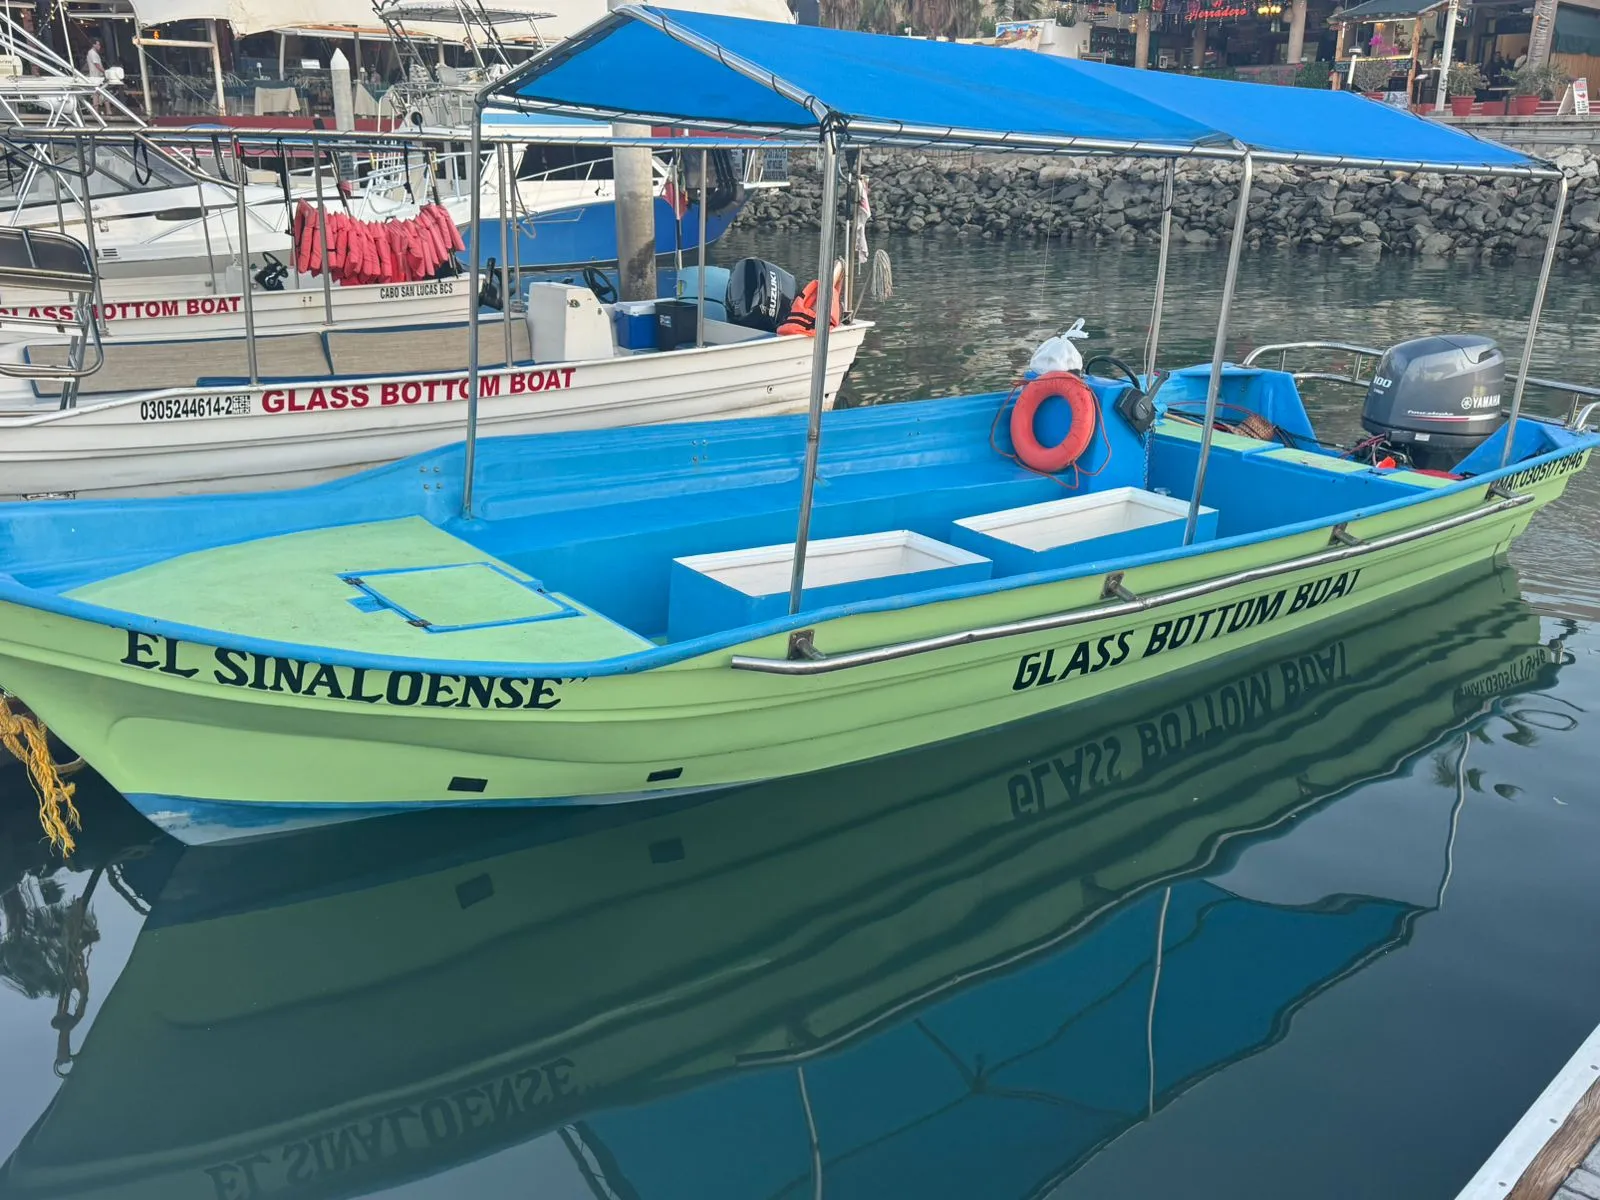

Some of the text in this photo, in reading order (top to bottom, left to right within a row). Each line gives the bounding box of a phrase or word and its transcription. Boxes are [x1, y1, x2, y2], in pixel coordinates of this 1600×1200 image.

[186, 297, 241, 315] BOAT
[380, 282, 453, 299] CABO SAN LUCAS BCS
[768, 271, 777, 318] SUZUKI
[262, 384, 369, 413] GLASS
[509, 368, 576, 394] BOAT
[1373, 376, 1392, 388] 100
[140, 396, 232, 420] 0305244614-2
[1012, 568, 1363, 691] GLASS BOTTOM BOAT
[120, 629, 199, 678] EL
